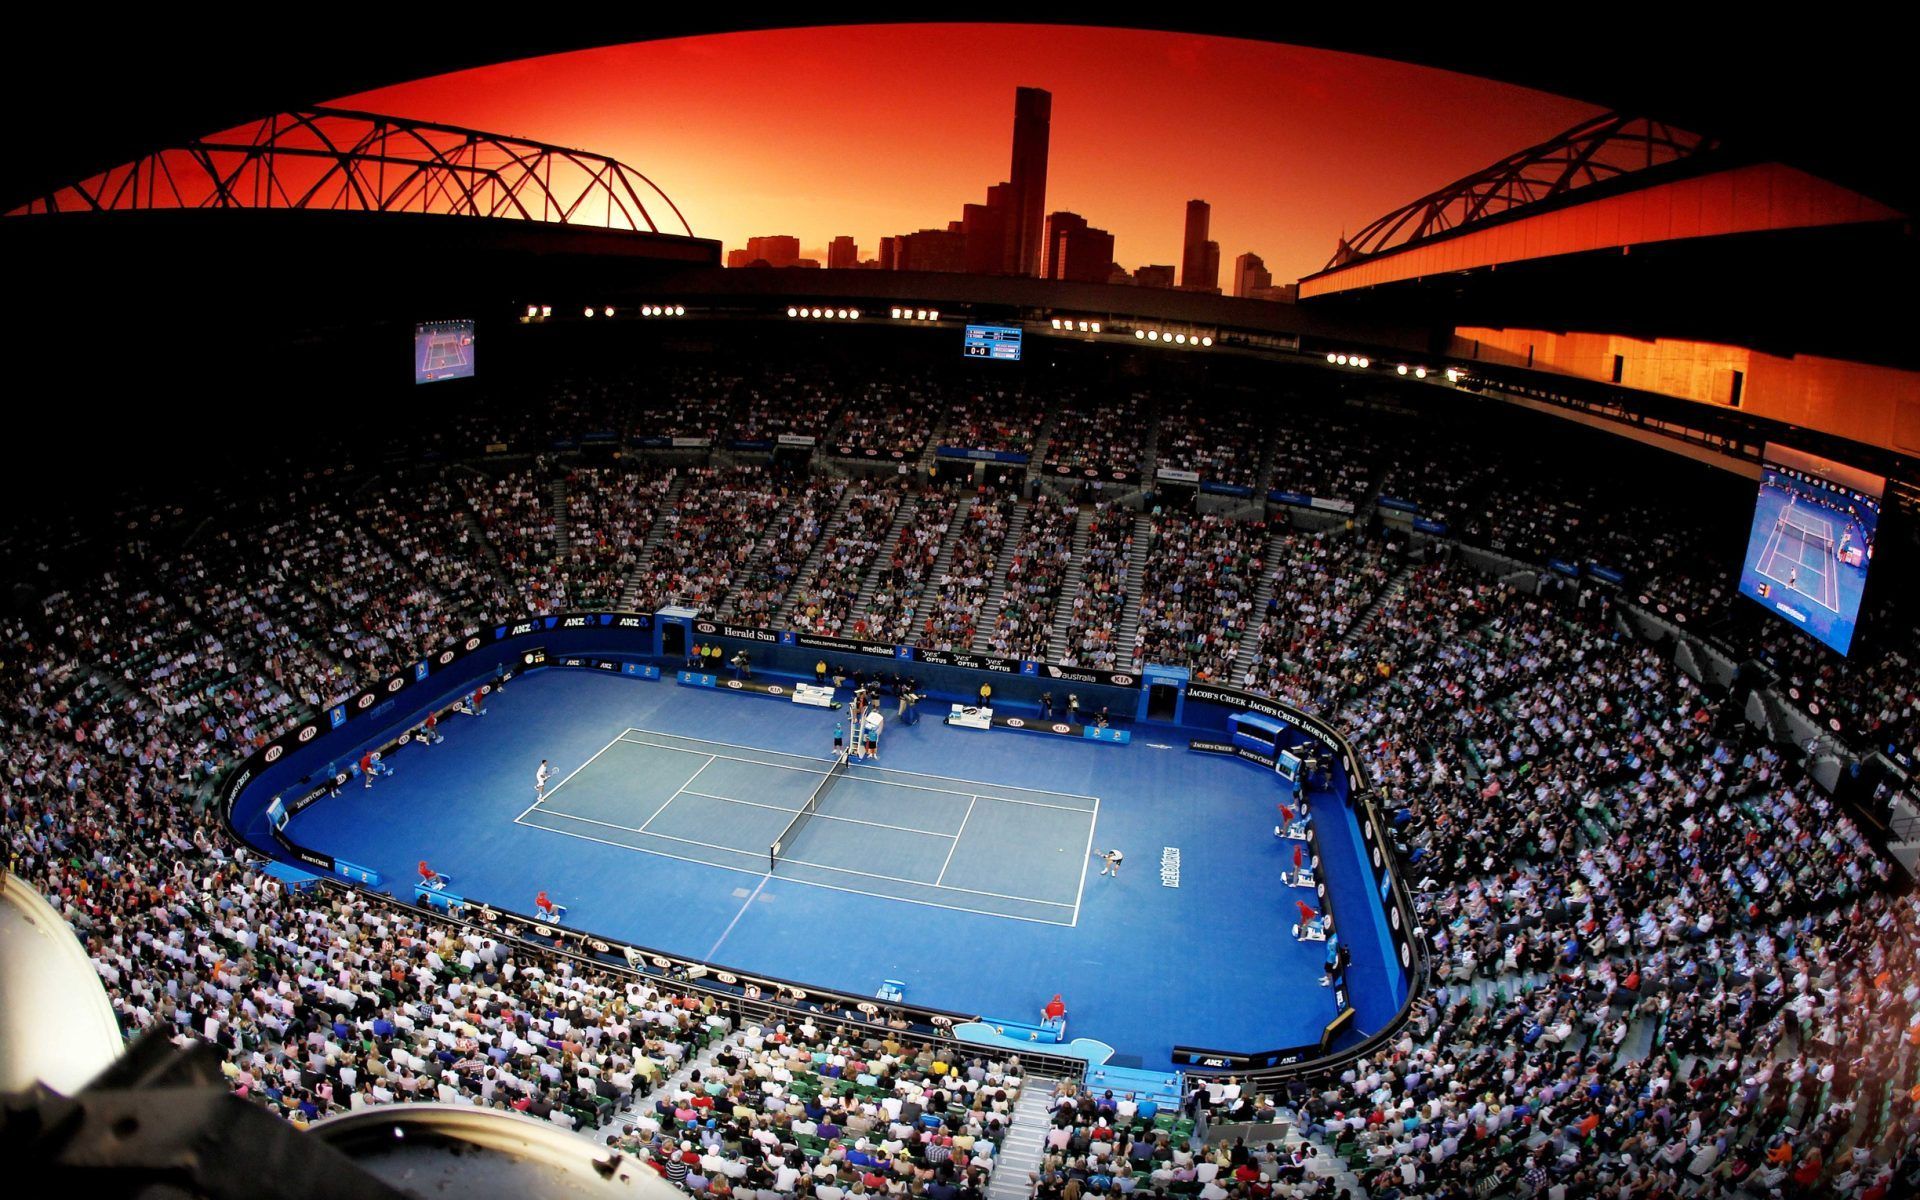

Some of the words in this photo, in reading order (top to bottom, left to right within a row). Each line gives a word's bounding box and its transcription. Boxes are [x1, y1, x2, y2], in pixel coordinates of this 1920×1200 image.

[564, 618, 585, 626] ANZ
[620, 618, 640, 626] ANZ
[512, 624, 531, 635] ANZ
[700, 624, 714, 632] KIA
[724, 626, 755, 640] Herald
[757, 630, 776, 642] Sun
[467, 640, 480, 650] KIA
[862, 645, 894, 656] medibank
[442, 652, 453, 664] KIA
[1062, 672, 1096, 682] australia
[1114, 676, 1130, 684] KIA
[390, 680, 402, 690] KIA
[360, 695, 374, 708] KIA
[1188, 688, 1218, 700] JACOB'S
[1220, 694, 1246, 706] CREEK
[1248, 700, 1276, 716] JACOB'S
[1277, 711, 1300, 726] CREEK
[302, 728, 316, 740] KIA
[267, 746, 282, 760] KIA
[537, 926, 550, 936] KIA
[655, 958, 669, 966] KIA
[933, 1017, 949, 1025] KIA
[1203, 1058, 1223, 1067] ANZ
[1280, 1056, 1296, 1064] ANZ
